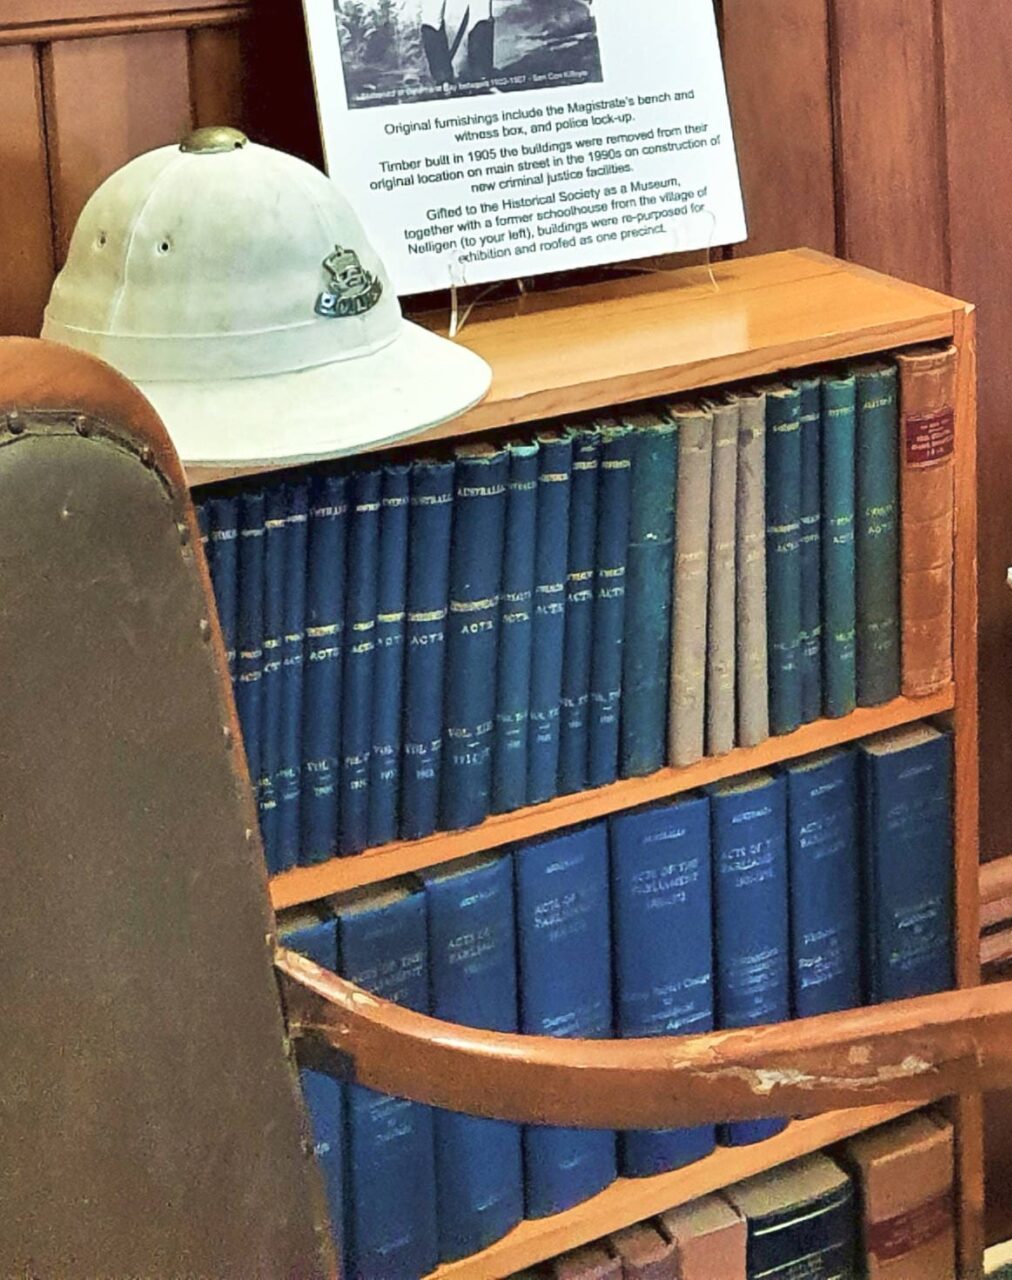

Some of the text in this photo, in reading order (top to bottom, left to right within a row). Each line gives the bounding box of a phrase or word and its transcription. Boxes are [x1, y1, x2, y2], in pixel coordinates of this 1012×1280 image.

[384, 89, 695, 137] Original furnishings include the Magistrate's bench and
[454, 111, 636, 143] witness box, and police lock-up.
[369, 134, 721, 192] original location on main street in the 1990s on construction of
[379, 122, 708, 173] Timber built in 1905 the buildings were removed from their
[426, 176, 681, 221] Gifted to the Historical Society as a Museum,
[471, 163, 634, 193] new criminal justice facilities.
[404, 186, 708, 241] together with a former schoolhouse from the village of
[408, 202, 705, 255] Nelligen (to your left), buildings were re-purposed for
[458, 224, 667, 265] exhibition and roofed as one precinct.
[461, 620, 494, 634] ACTS
